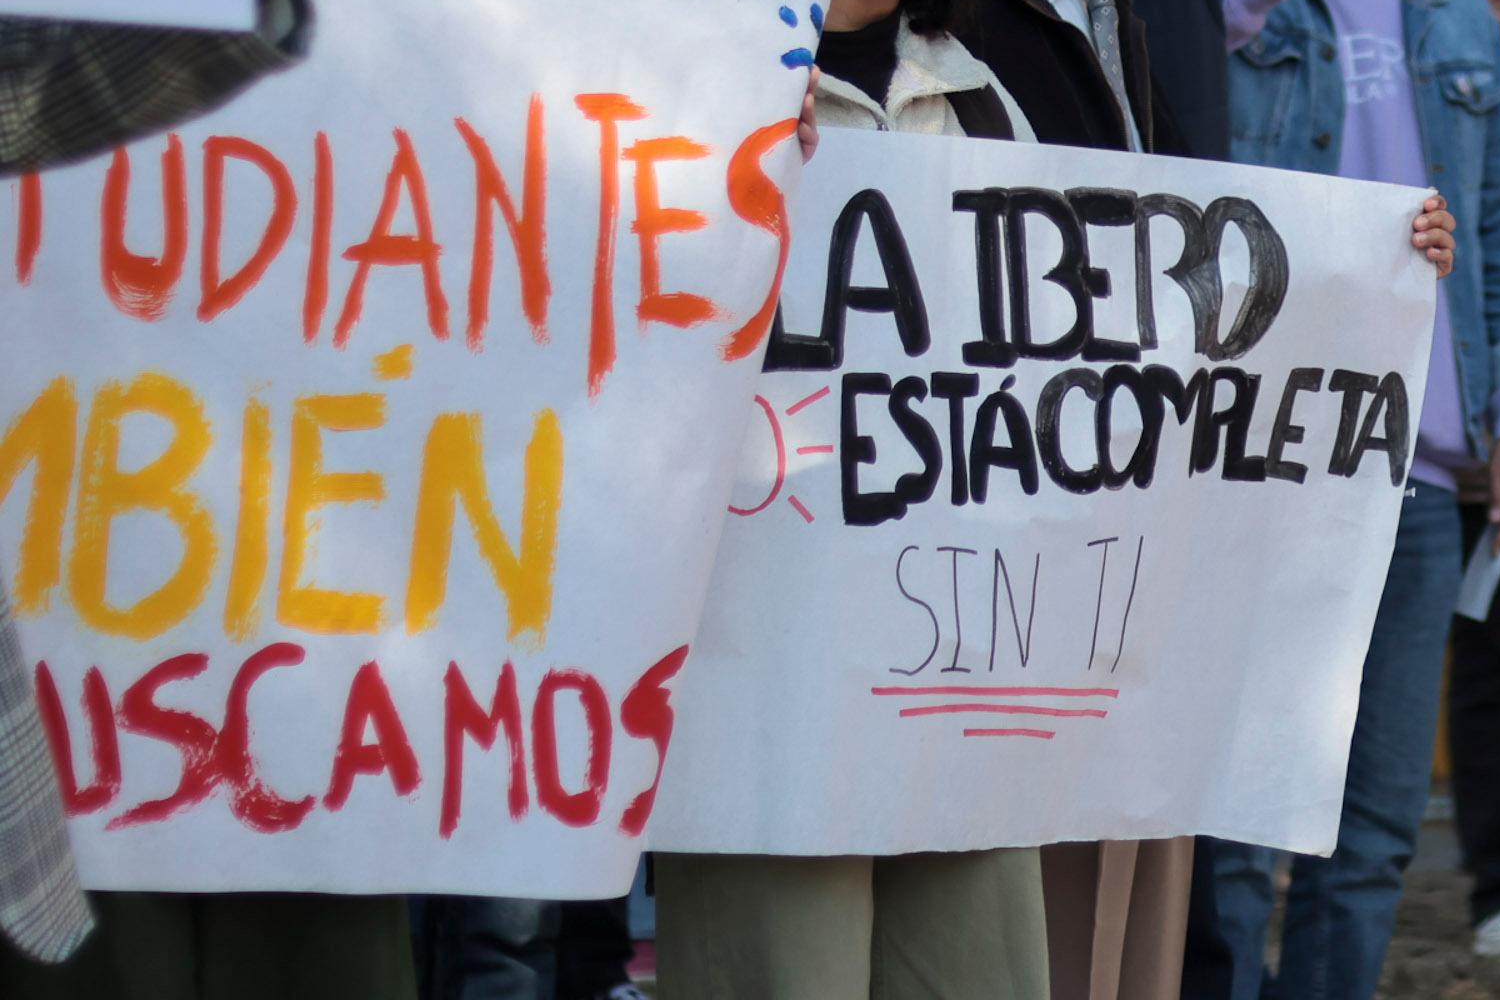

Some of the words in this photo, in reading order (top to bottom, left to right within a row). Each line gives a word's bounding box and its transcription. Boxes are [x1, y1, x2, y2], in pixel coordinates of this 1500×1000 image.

[952, 185, 1289, 368] IBERO
[889, 544, 1041, 676] SIN
[1086, 534, 1145, 673] TI
